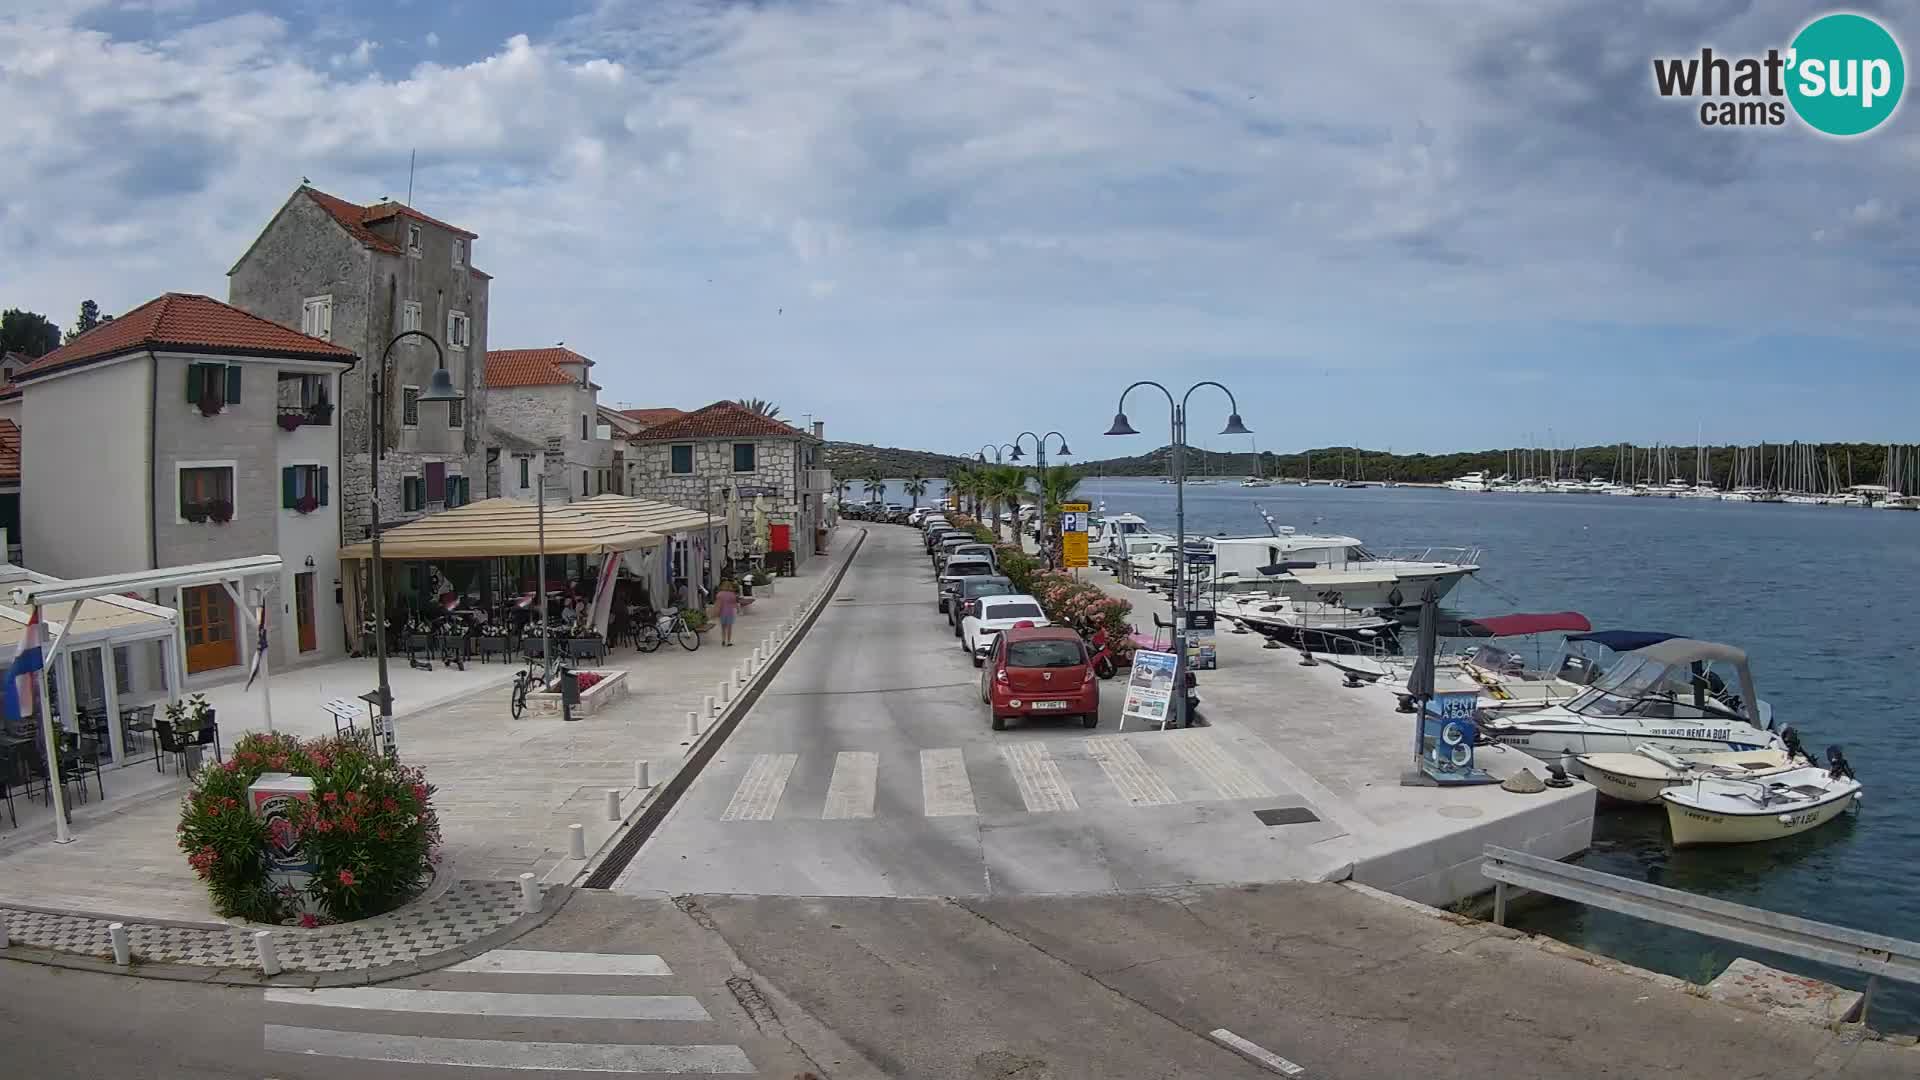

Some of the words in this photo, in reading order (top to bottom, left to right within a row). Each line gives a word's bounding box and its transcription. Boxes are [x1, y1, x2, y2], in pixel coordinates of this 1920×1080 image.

[1065, 514, 1076, 530] P
[1443, 699, 1475, 711] RENT
[1442, 710, 1449, 719] A
[1451, 710, 1473, 719] BOAT
[1686, 728, 1705, 738] RENT
[1706, 729, 1712, 739] A
[1712, 729, 1731, 740] BOAT
